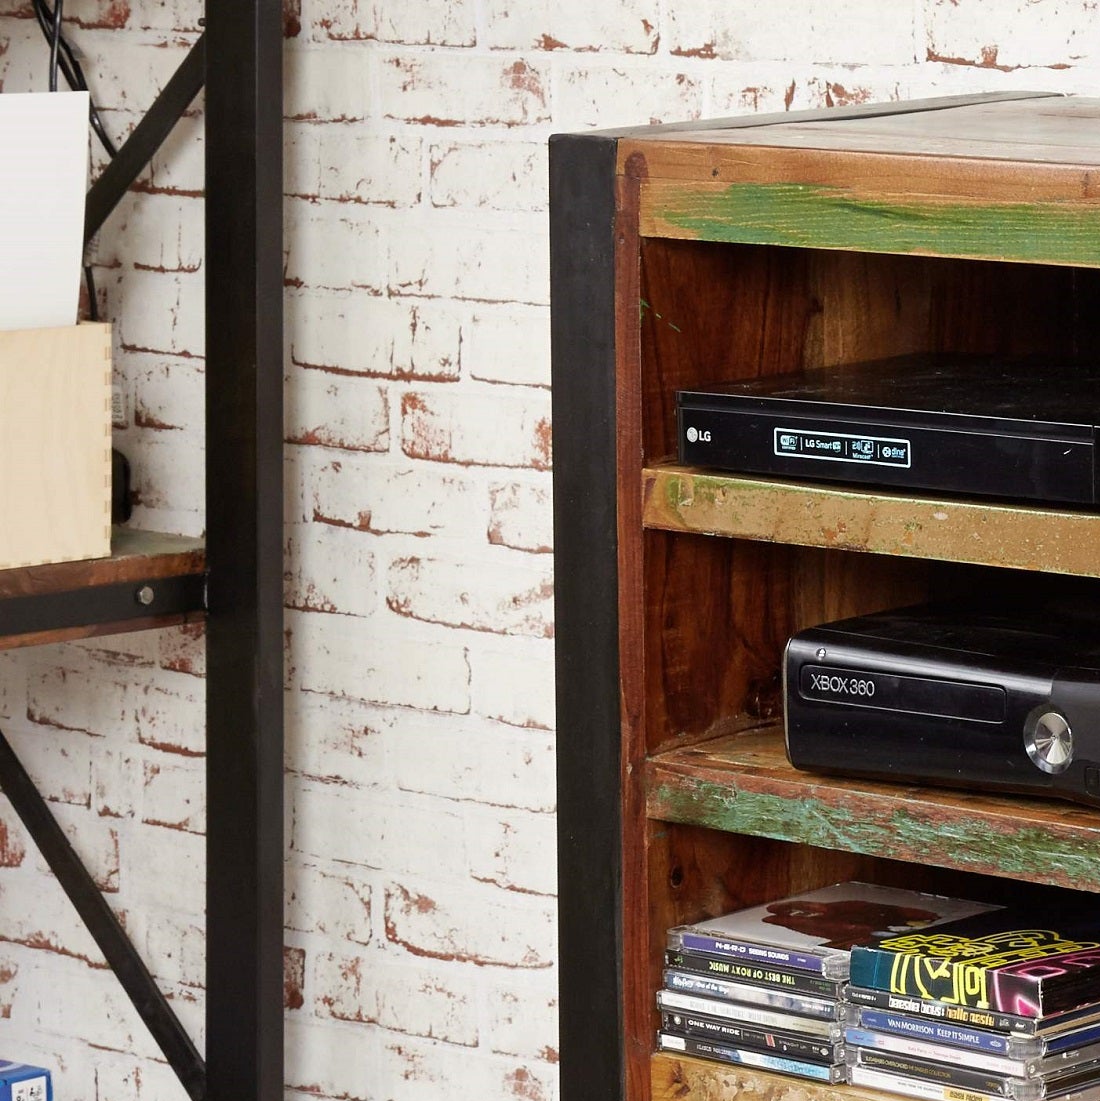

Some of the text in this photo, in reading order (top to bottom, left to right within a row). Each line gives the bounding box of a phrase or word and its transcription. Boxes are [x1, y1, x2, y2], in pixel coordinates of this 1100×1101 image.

[698, 430, 711, 442] LG
[805, 439, 815, 448] LG
[816, 441, 832, 450] Smart
[811, 674, 875, 697] XBOX 360
[767, 949, 790, 961] SOUNDS
[708, 961, 730, 973] MUSIC
[730, 964, 752, 977] ROXY
[752, 968, 764, 979] OF
[764, 971, 781, 983] BEST
[781, 975, 796, 985] THE
[888, 994, 920, 1013] beastie
[946, 1006, 968, 1022] hello
[969, 1012, 995, 1027] nasty
[687, 1019, 741, 1036] ONE WAY RIDE
[887, 1018, 900, 1029] VAN
[900, 1021, 934, 1035] MORRISON
[936, 1025, 951, 1038] KEEP
[958, 1029, 980, 1044] SIMPLE
